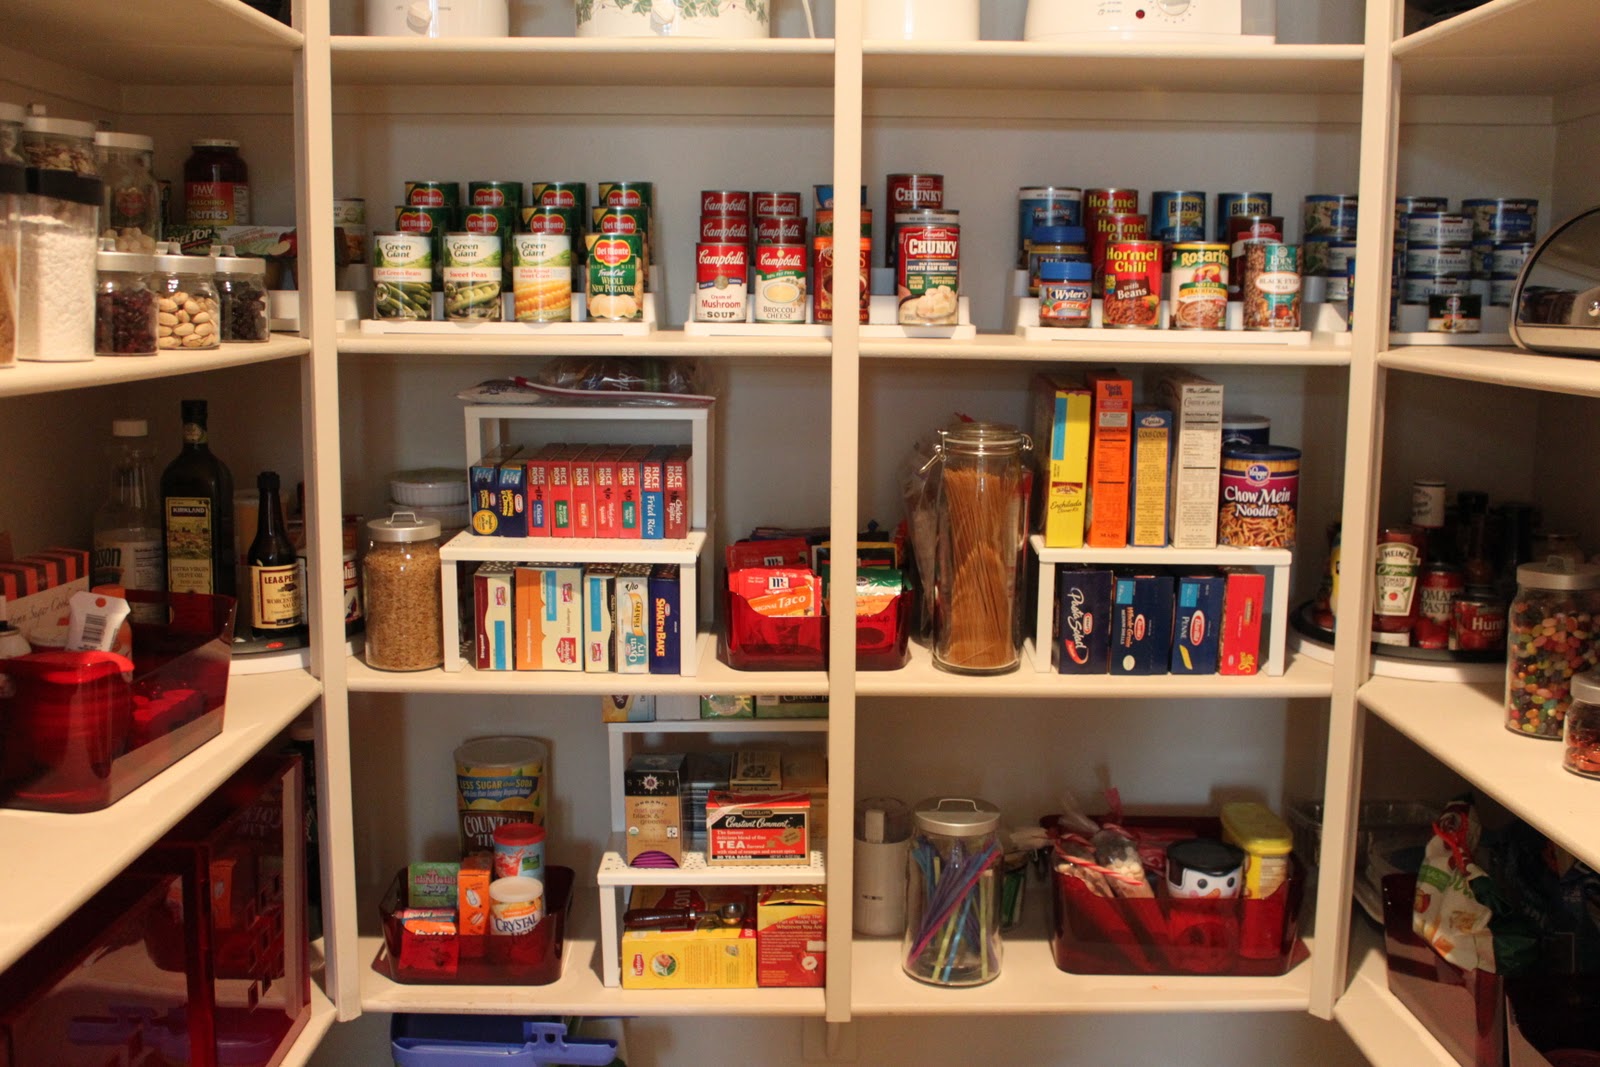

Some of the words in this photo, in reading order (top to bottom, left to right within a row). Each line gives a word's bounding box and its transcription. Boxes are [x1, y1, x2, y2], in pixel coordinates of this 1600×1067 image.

[895, 188, 942, 202] CHUNKY
[1088, 195, 1136, 208] Hormel
[1098, 220, 1146, 233] Hormel
[191, 228, 212, 240] TOP
[385, 242, 412, 251] Green
[453, 242, 478, 250] Green
[521, 242, 546, 250] Green
[596, 246, 607, 256] Del
[608, 248, 628, 256] Monte
[908, 238, 957, 257] CHUNKY
[386, 250, 410, 258] Giant
[454, 250, 477, 258] Giant
[522, 249, 545, 257] Giant
[699, 249, 744, 267] Campbell's
[1107, 248, 1158, 261] Hormel
[760, 253, 802, 268] Campbell's
[1114, 260, 1146, 273] Chili
[602, 276, 624, 284] WHOLE
[604, 284, 634, 292] POTATOES
[1054, 289, 1087, 300] Wyler's
[1118, 288, 1148, 300] Beans
[702, 300, 741, 308] Mushroom
[706, 310, 736, 318] SOUP
[652, 466, 660, 489] RICE
[674, 466, 682, 488] RICE
[1224, 486, 1258, 502] Chow
[1258, 487, 1291, 506] Mein
[647, 495, 656, 516] Fried
[666, 502, 675, 521] Fajita
[1050, 500, 1082, 510] Enchilada
[1235, 504, 1280, 517] Noodles
[675, 500, 683, 524] Chicken
[648, 518, 656, 536] Rice
[1384, 550, 1410, 558] HEINZ
[264, 576, 278, 584] LEA
[778, 596, 806, 608] Taco
[1067, 587, 1084, 619] Pasta
[655, 598, 666, 624] SHAKE
[1126, 606, 1134, 628] Whole
[1068, 616, 1087, 648] Salad
[1180, 616, 1190, 639] PENNE
[1194, 618, 1202, 642] Barilla
[656, 632, 666, 657] BAKE
[1125, 628, 1134, 648] Grain
[629, 638, 637, 662] Oven
[476, 780, 502, 790] SUGAR
[516, 779, 533, 788] SODA
[717, 840, 746, 848] TEA
[495, 915, 537, 932] CRYSTAL
